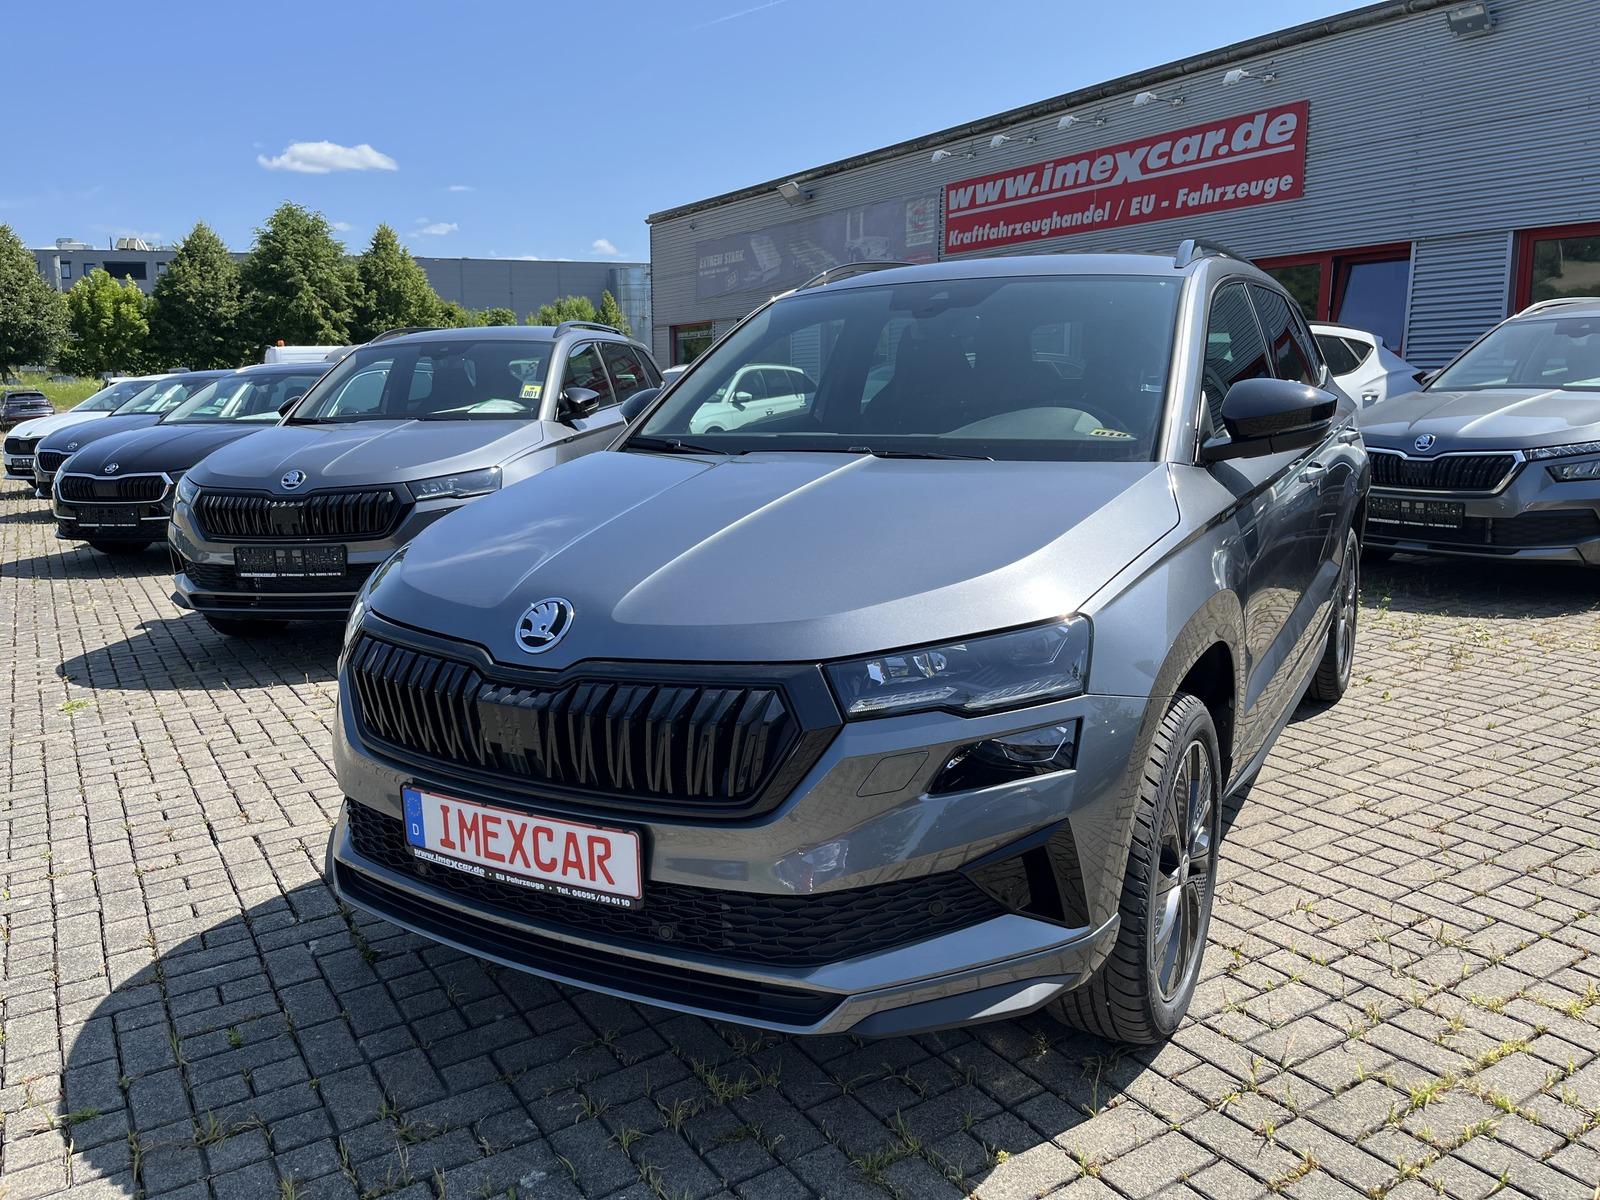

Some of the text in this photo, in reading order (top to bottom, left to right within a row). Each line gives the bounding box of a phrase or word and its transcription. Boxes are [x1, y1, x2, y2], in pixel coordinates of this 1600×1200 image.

[949, 112, 1297, 210] www.imexcar.de
[949, 201, 1111, 247] Kraftfahrzeughandel
[1130, 195, 1155, 216] EU
[1175, 172, 1295, 209] Fahrzeuge
[412, 823, 420, 836] D
[440, 804, 615, 886] IMEXCAR
[414, 848, 485, 877] www.imexcar.de
[495, 872, 506, 881] EU
[506, 875, 545, 890] Fahrzeuge
[556, 886, 571, 895] Tel.
